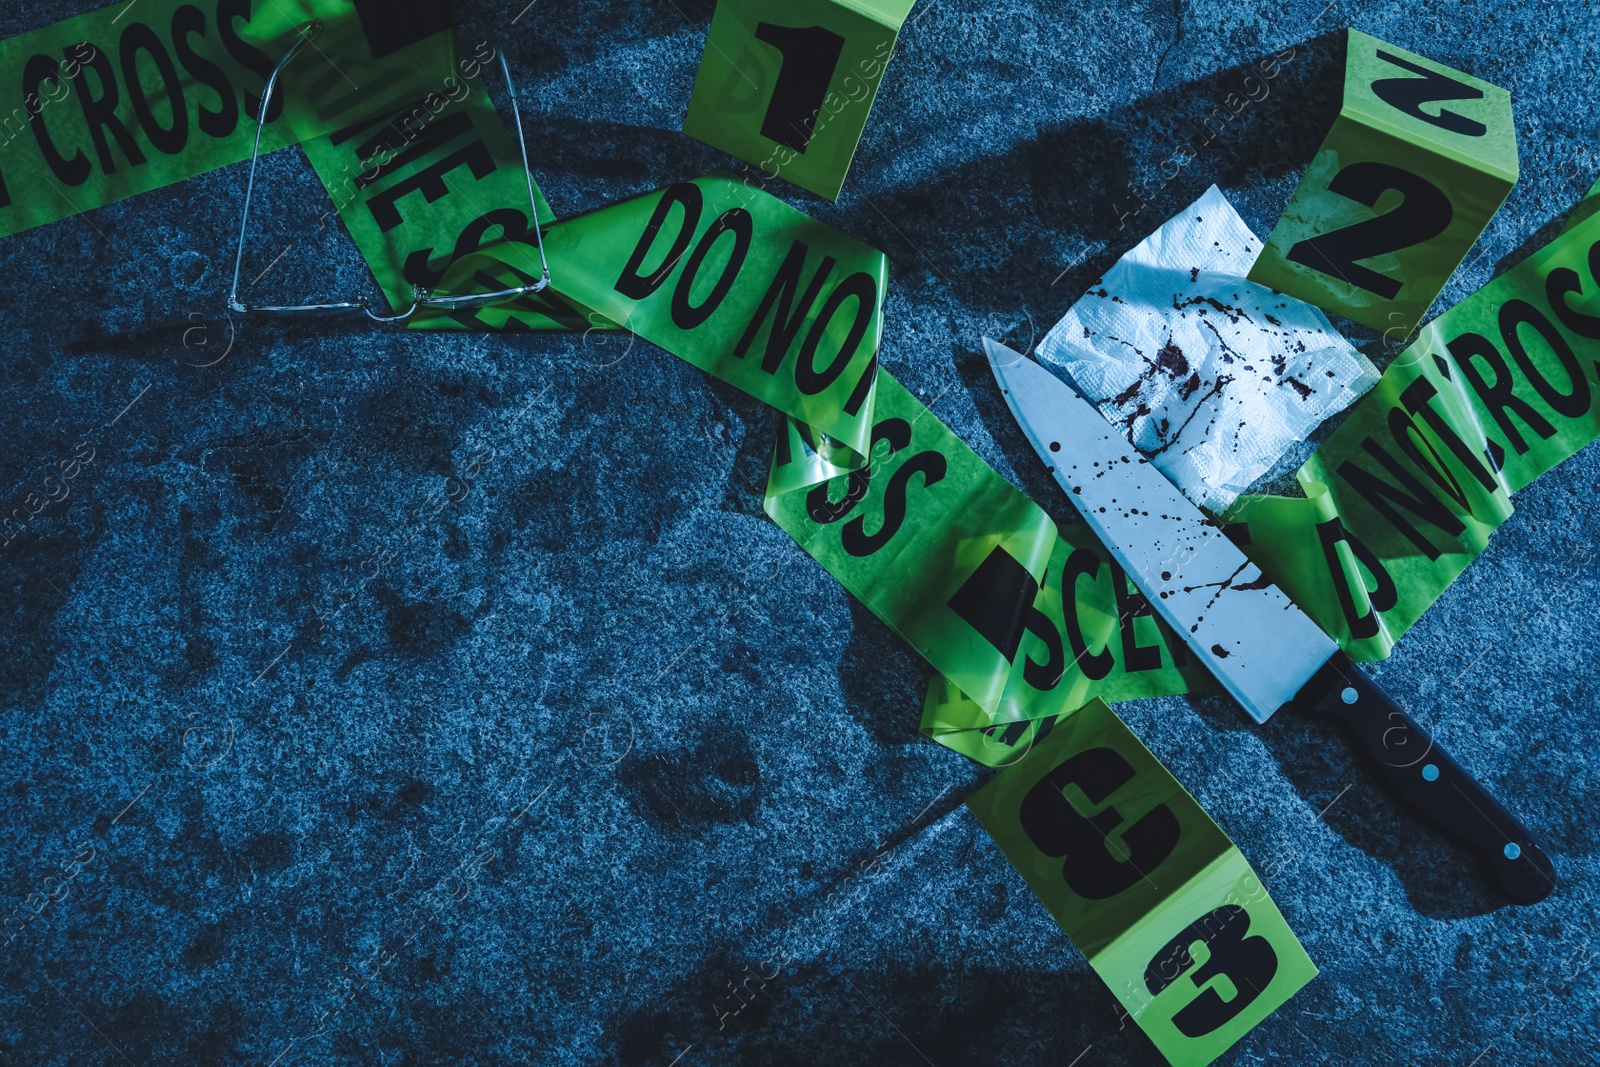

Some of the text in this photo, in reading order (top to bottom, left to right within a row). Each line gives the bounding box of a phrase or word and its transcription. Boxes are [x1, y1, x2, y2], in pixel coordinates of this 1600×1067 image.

[23, 0, 284, 187] CROSS
[755, 21, 846, 155] 1
[1371, 49, 1487, 137] 2
[613, 182, 753, 331] DO
[1286, 161, 1454, 300] 2
[1337, 375, 1498, 561] NOT
[1019, 747, 1181, 900] 3
[1143, 904, 1278, 1038] 3
